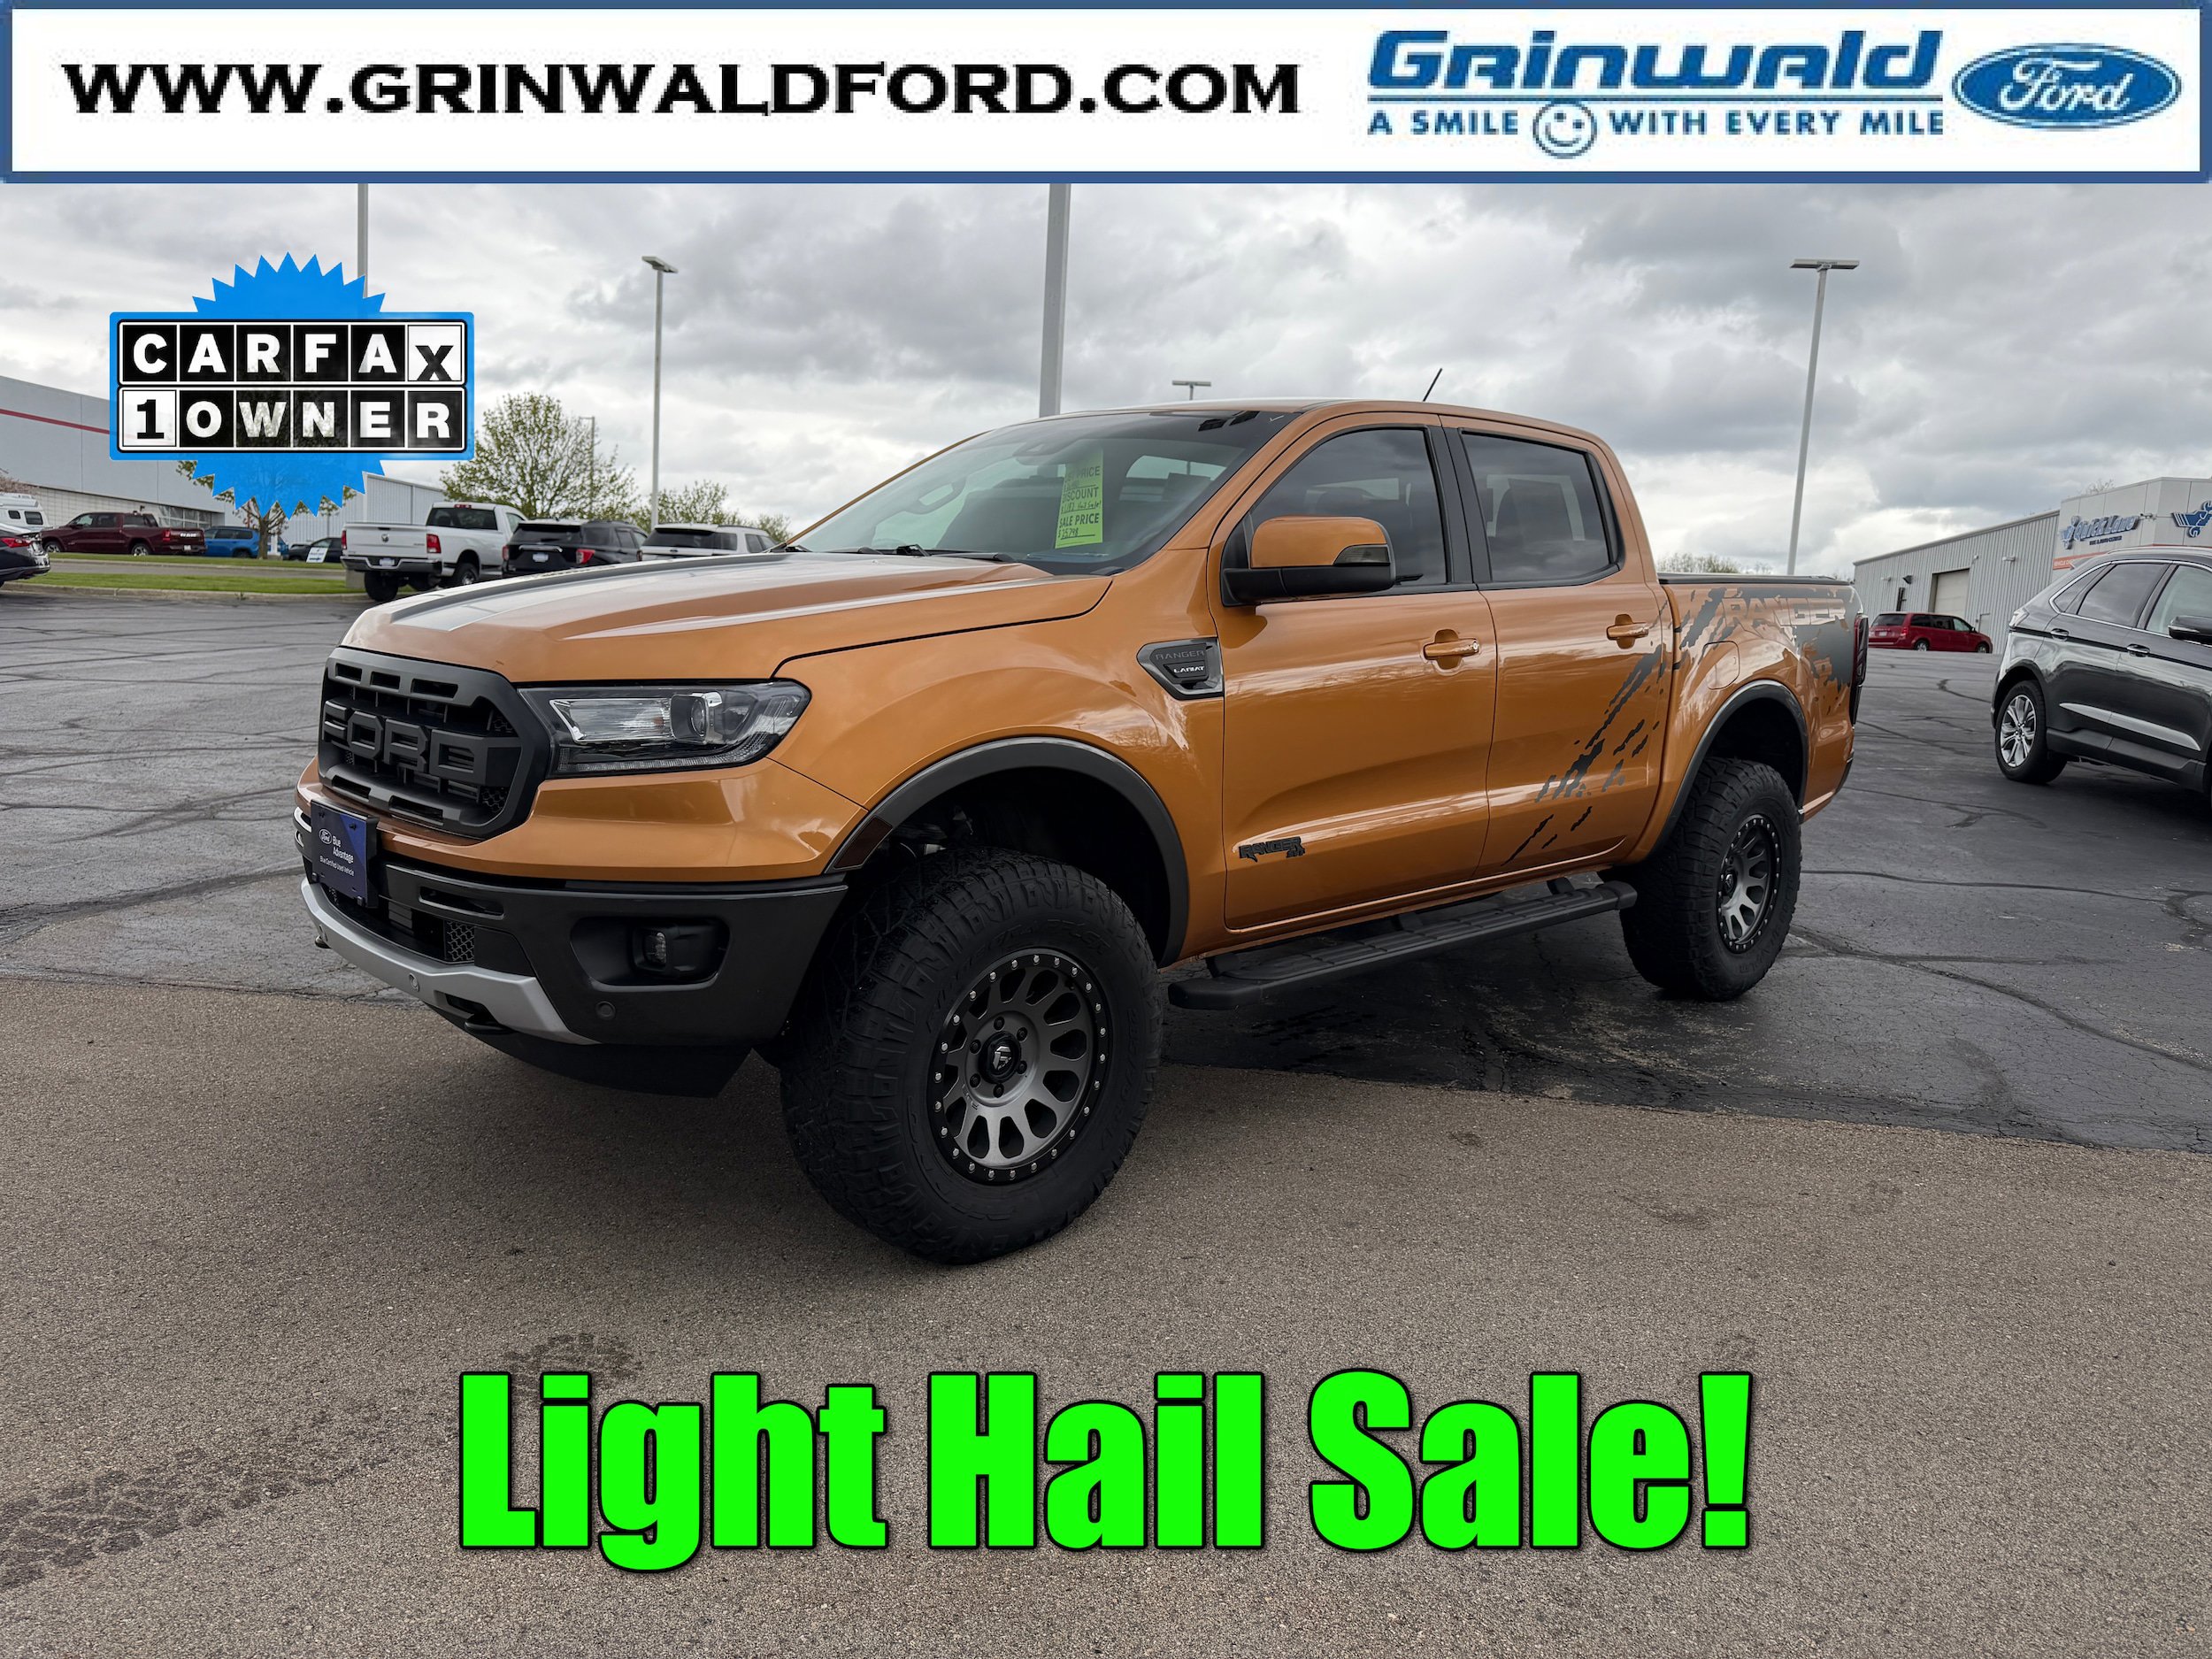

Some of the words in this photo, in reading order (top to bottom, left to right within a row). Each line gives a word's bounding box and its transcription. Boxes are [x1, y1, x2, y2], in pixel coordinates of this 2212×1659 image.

[1059, 516, 1073, 528] SALE
[1075, 513, 1100, 526] PRICE
[1722, 597, 1847, 628] RANGER
[1155, 650, 1204, 660] RANGER
[322, 699, 487, 786] FORD
[333, 835, 342, 848] Blue
[333, 847, 354, 864] Advantage
